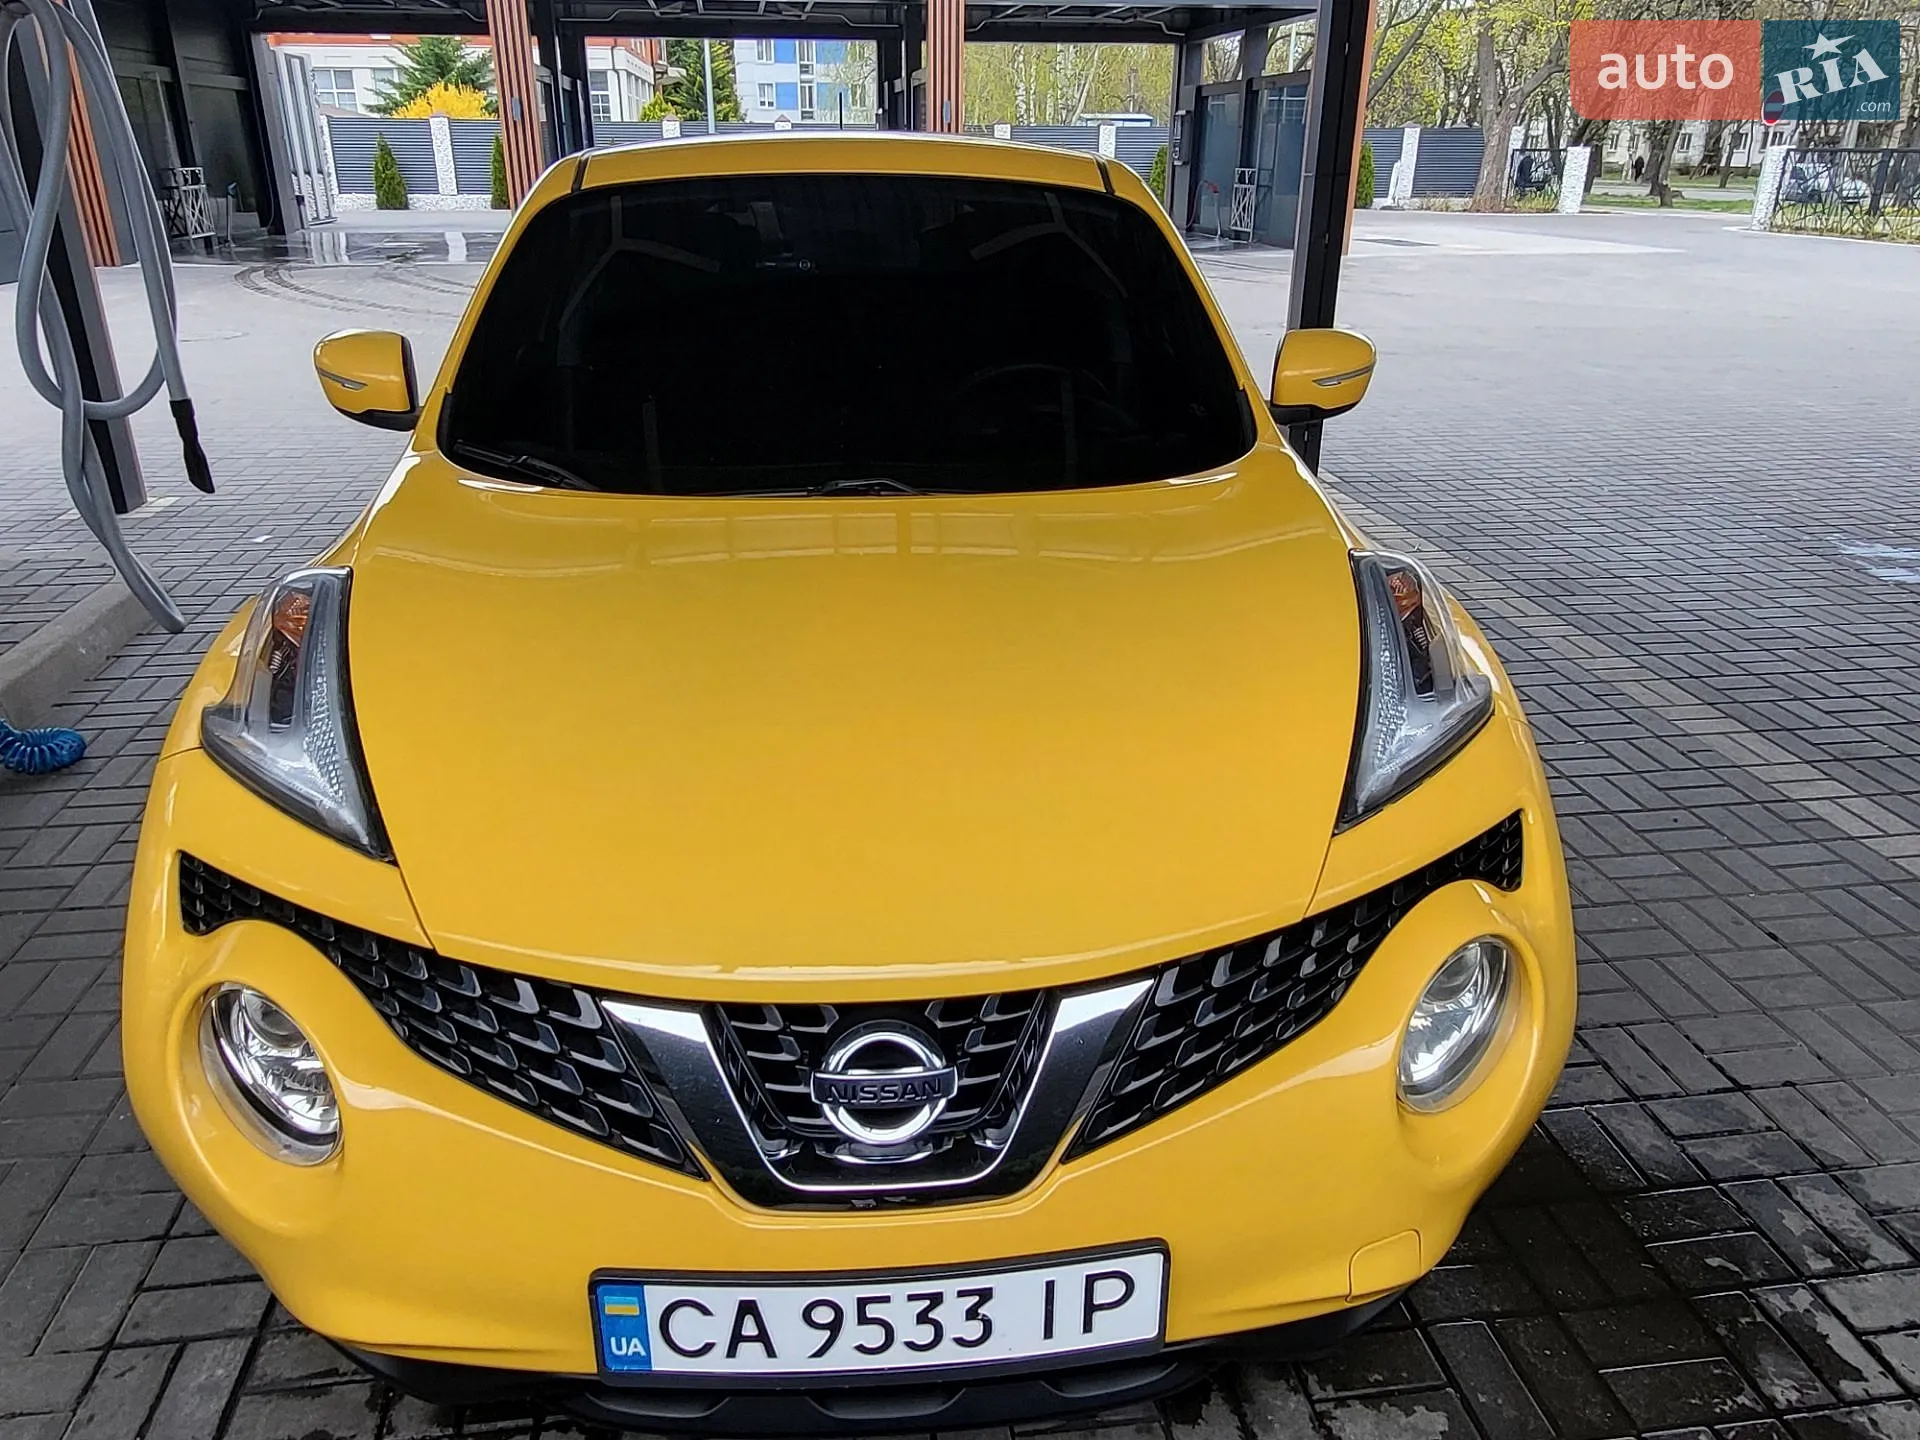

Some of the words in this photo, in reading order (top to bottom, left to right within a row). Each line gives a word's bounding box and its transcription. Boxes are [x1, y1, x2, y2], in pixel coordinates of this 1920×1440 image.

[828, 1077, 943, 1104] NISSAN
[658, 1299, 777, 1359] CA
[802, 1287, 994, 1358] 9533
[1042, 1269, 1136, 1340] IP
[610, 1337, 646, 1358] UA
